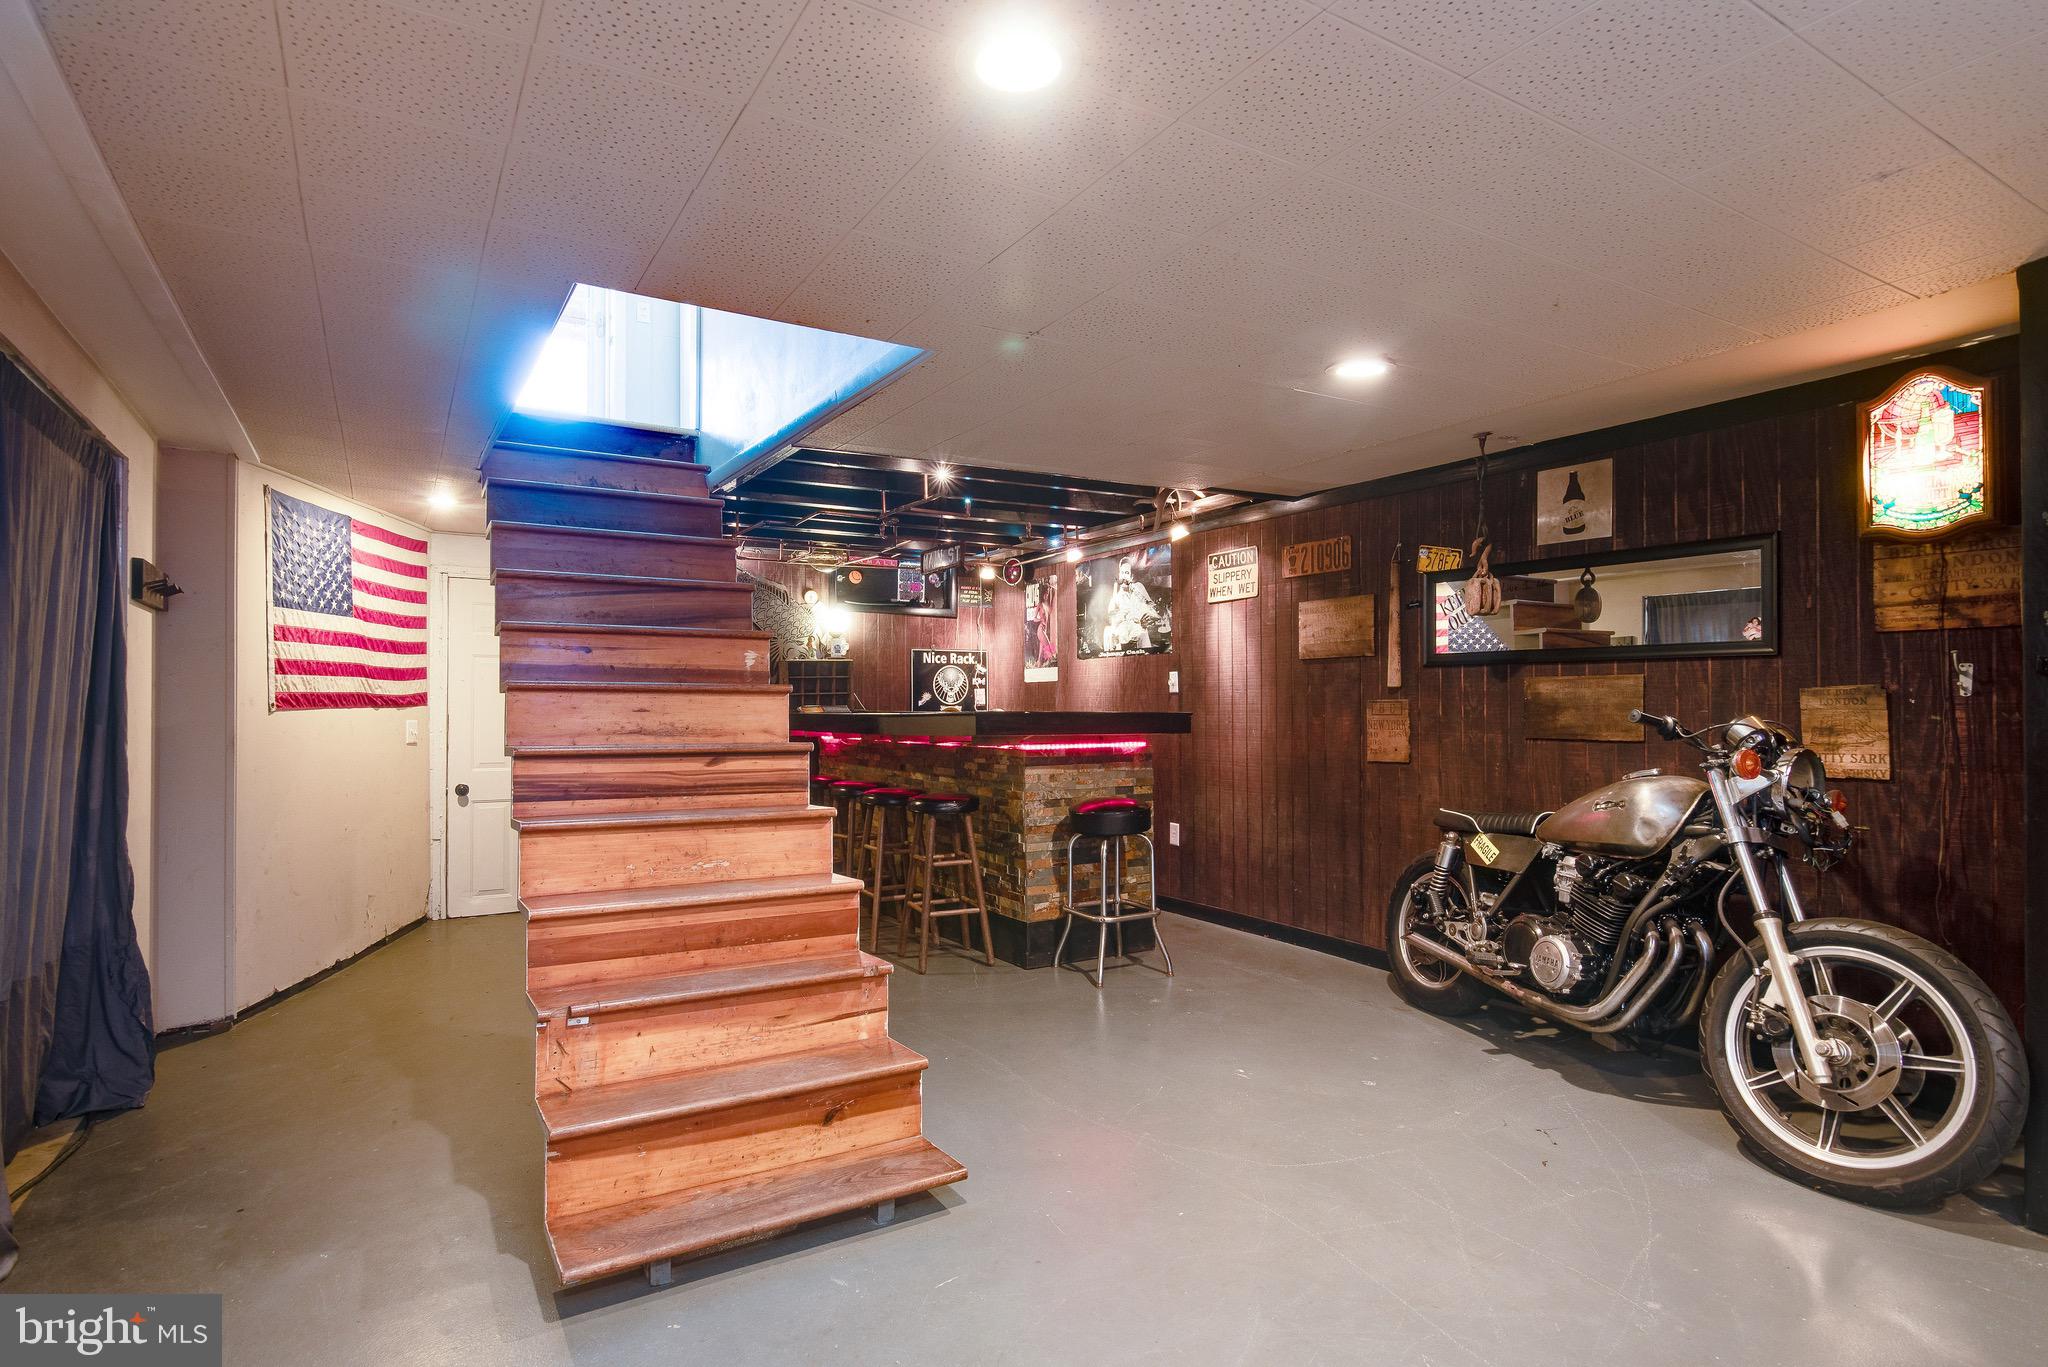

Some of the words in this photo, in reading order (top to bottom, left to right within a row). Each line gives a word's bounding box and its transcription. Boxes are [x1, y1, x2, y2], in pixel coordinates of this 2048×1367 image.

[1211, 550, 1254, 569] CAUTION
[1213, 568, 1252, 584] SLIPPERY
[1210, 585, 1233, 597] WHEN
[1239, 581, 1256, 594] WET
[1908, 579, 1976, 598] CUTY
[1448, 608, 1474, 631] OU
[923, 652, 947, 664] Nice
[949, 652, 978, 665] Rack.
[1820, 697, 1868, 706] LONDON
[1850, 753, 1888, 765] SARK
[1474, 835, 1497, 862] FRAGILE
